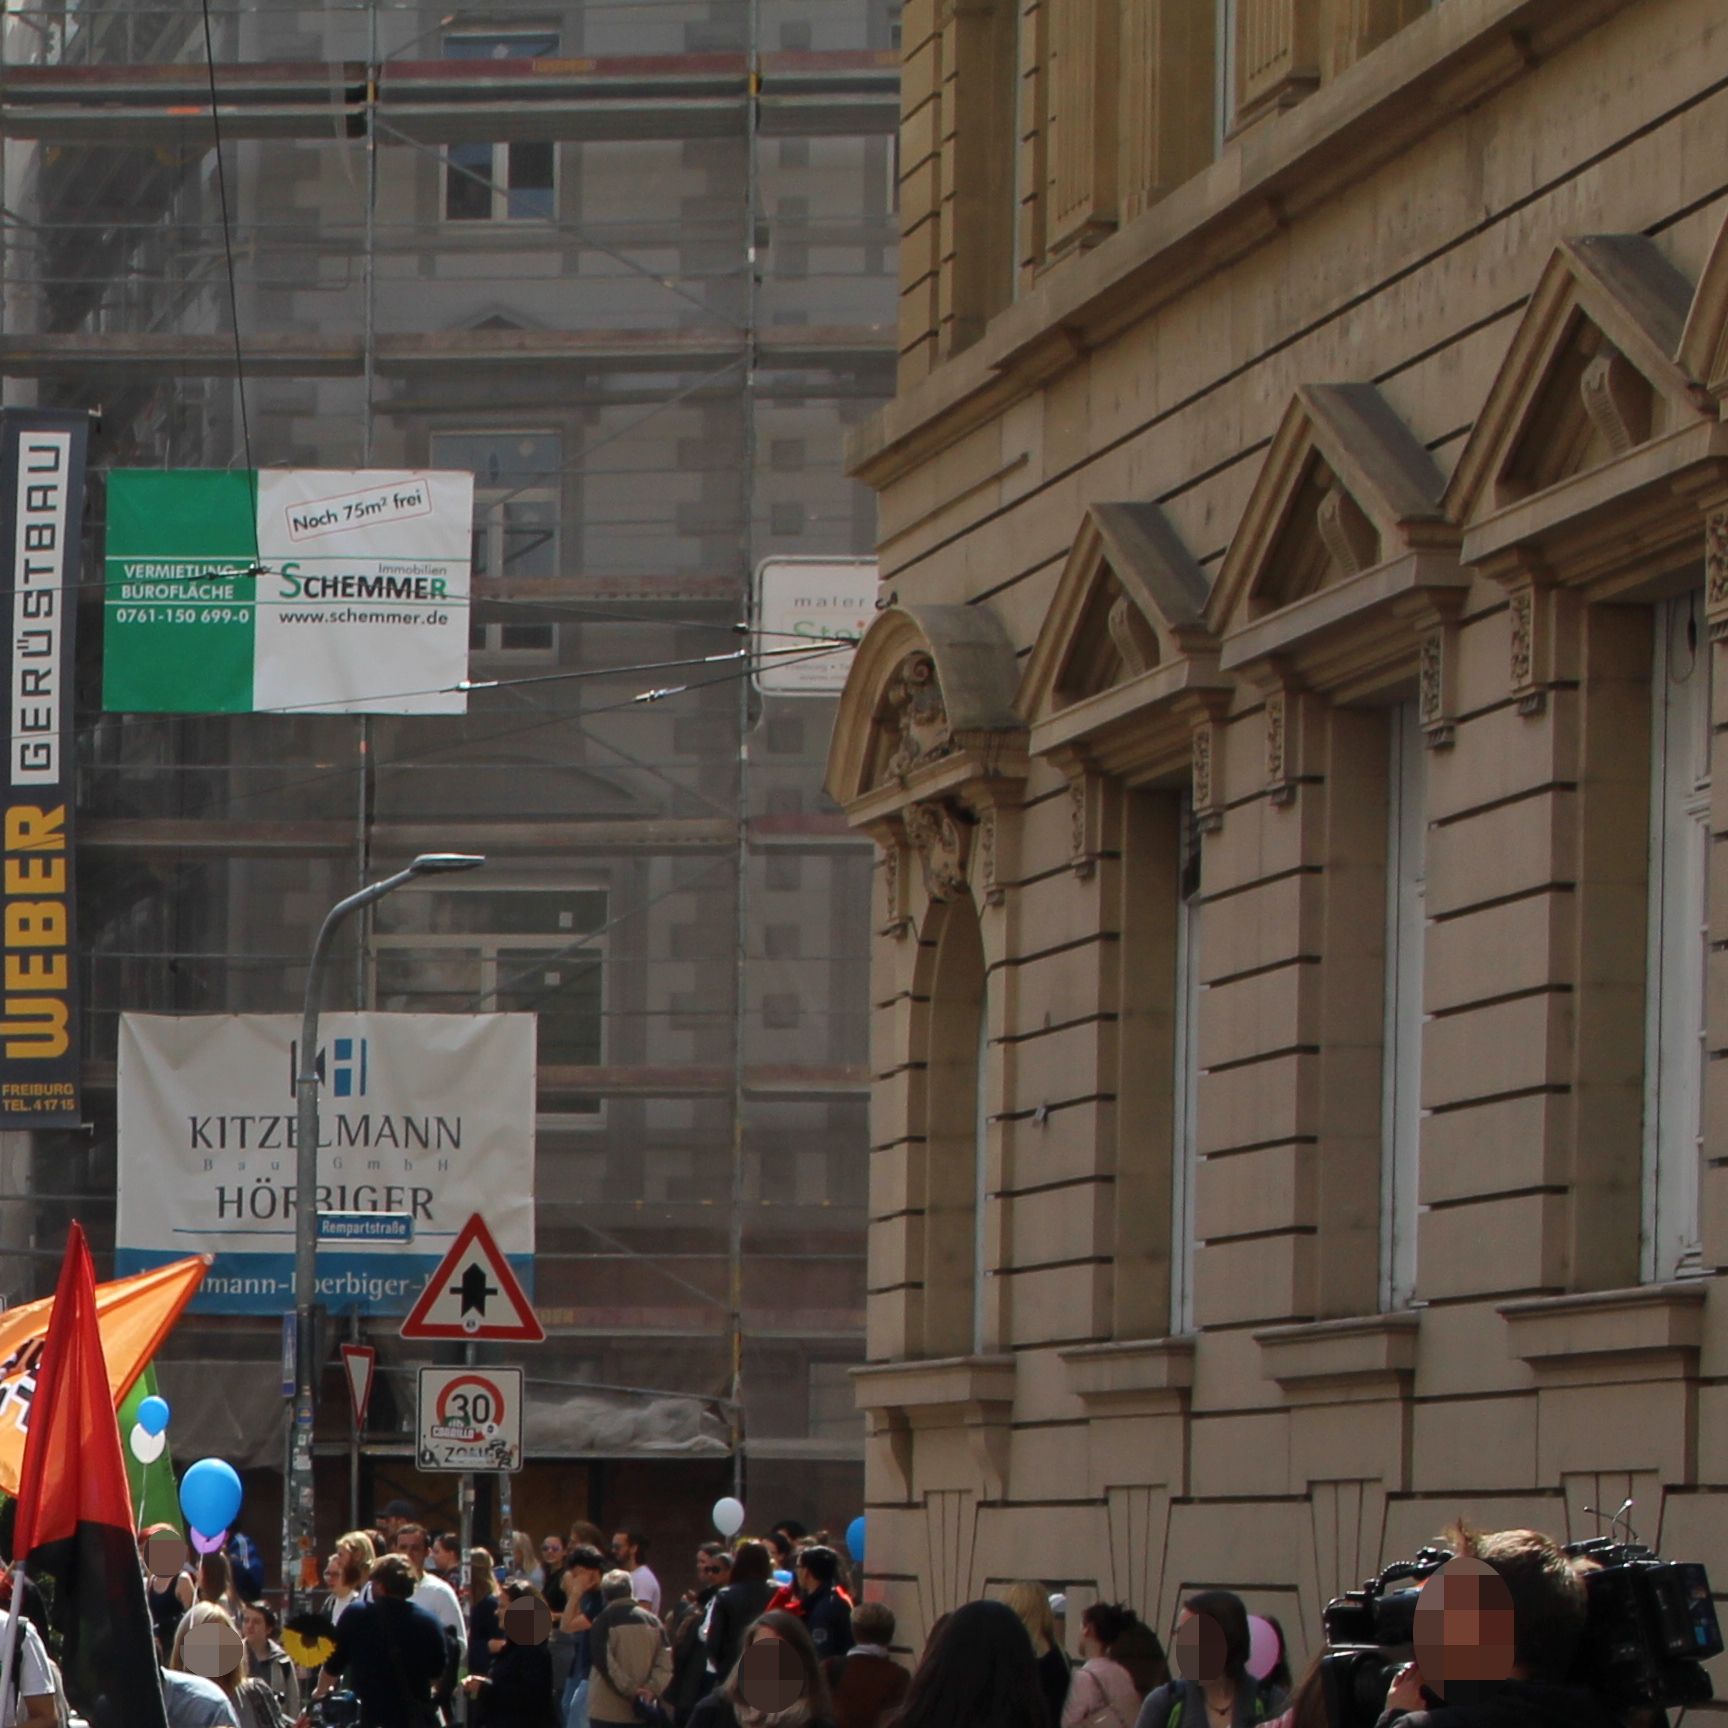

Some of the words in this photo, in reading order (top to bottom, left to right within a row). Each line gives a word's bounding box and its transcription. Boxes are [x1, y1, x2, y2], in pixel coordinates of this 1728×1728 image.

[292, 509, 339, 533] Noch
[392, 488, 422, 511] frei
[378, 563, 448, 576] Immobilien
[121, 582, 235, 600] BÜROFLÄCHE
[16, 444, 62, 772] GERÜSTBAU
[116, 608, 198, 624] 0761-150
[200, 608, 250, 624] 699-0
[279, 607, 449, 626] www.schemmer.de
[2, 1083, 74, 1097] FREIBURG
[321, 1218, 407, 1238] Rempartstraße
[450, 1393, 490, 1424] 30
